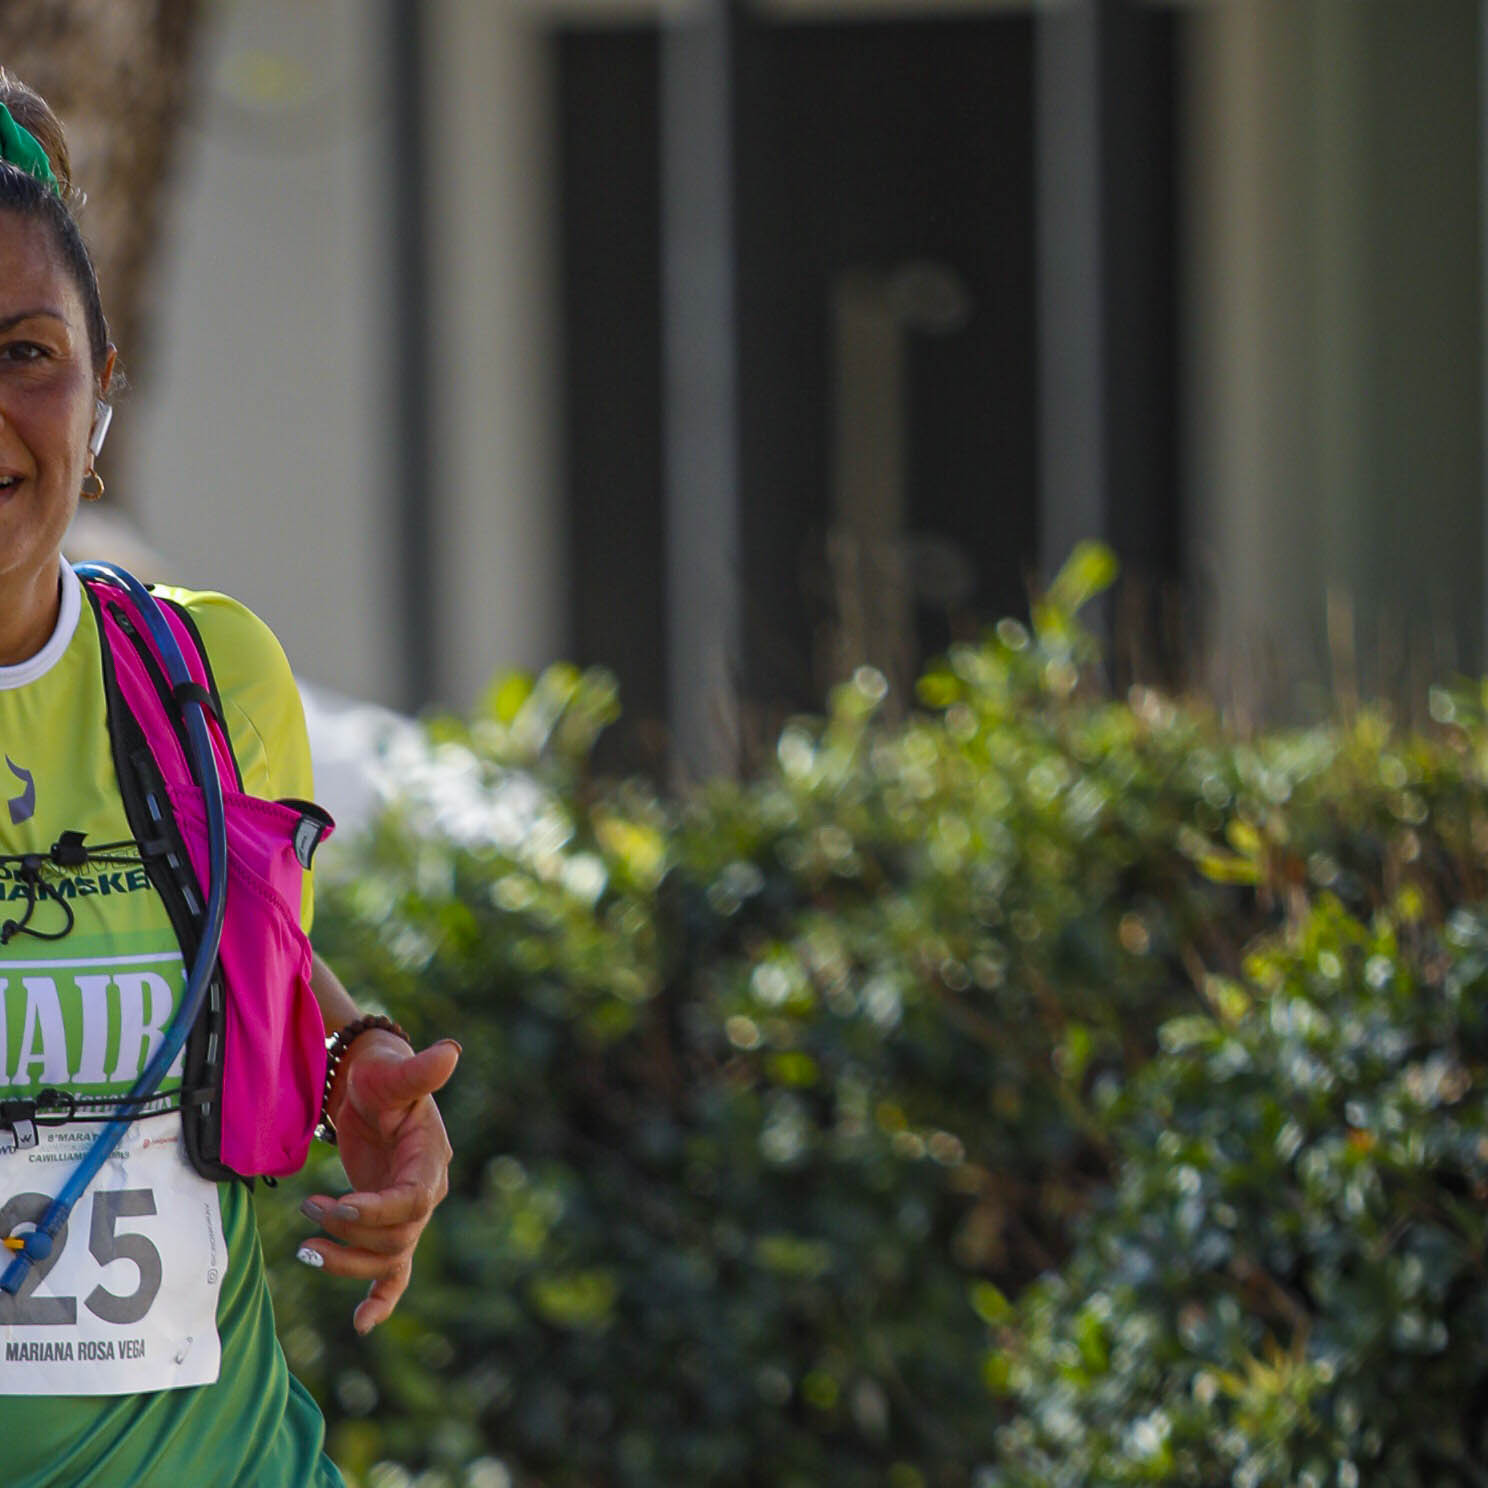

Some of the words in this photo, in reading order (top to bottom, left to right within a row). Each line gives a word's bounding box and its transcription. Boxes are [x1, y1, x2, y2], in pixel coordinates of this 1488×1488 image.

[6, 1342, 74, 1361] MARIANA
[78, 1340, 115, 1361] ROSA
[118, 1339, 145, 1359] VEGA
